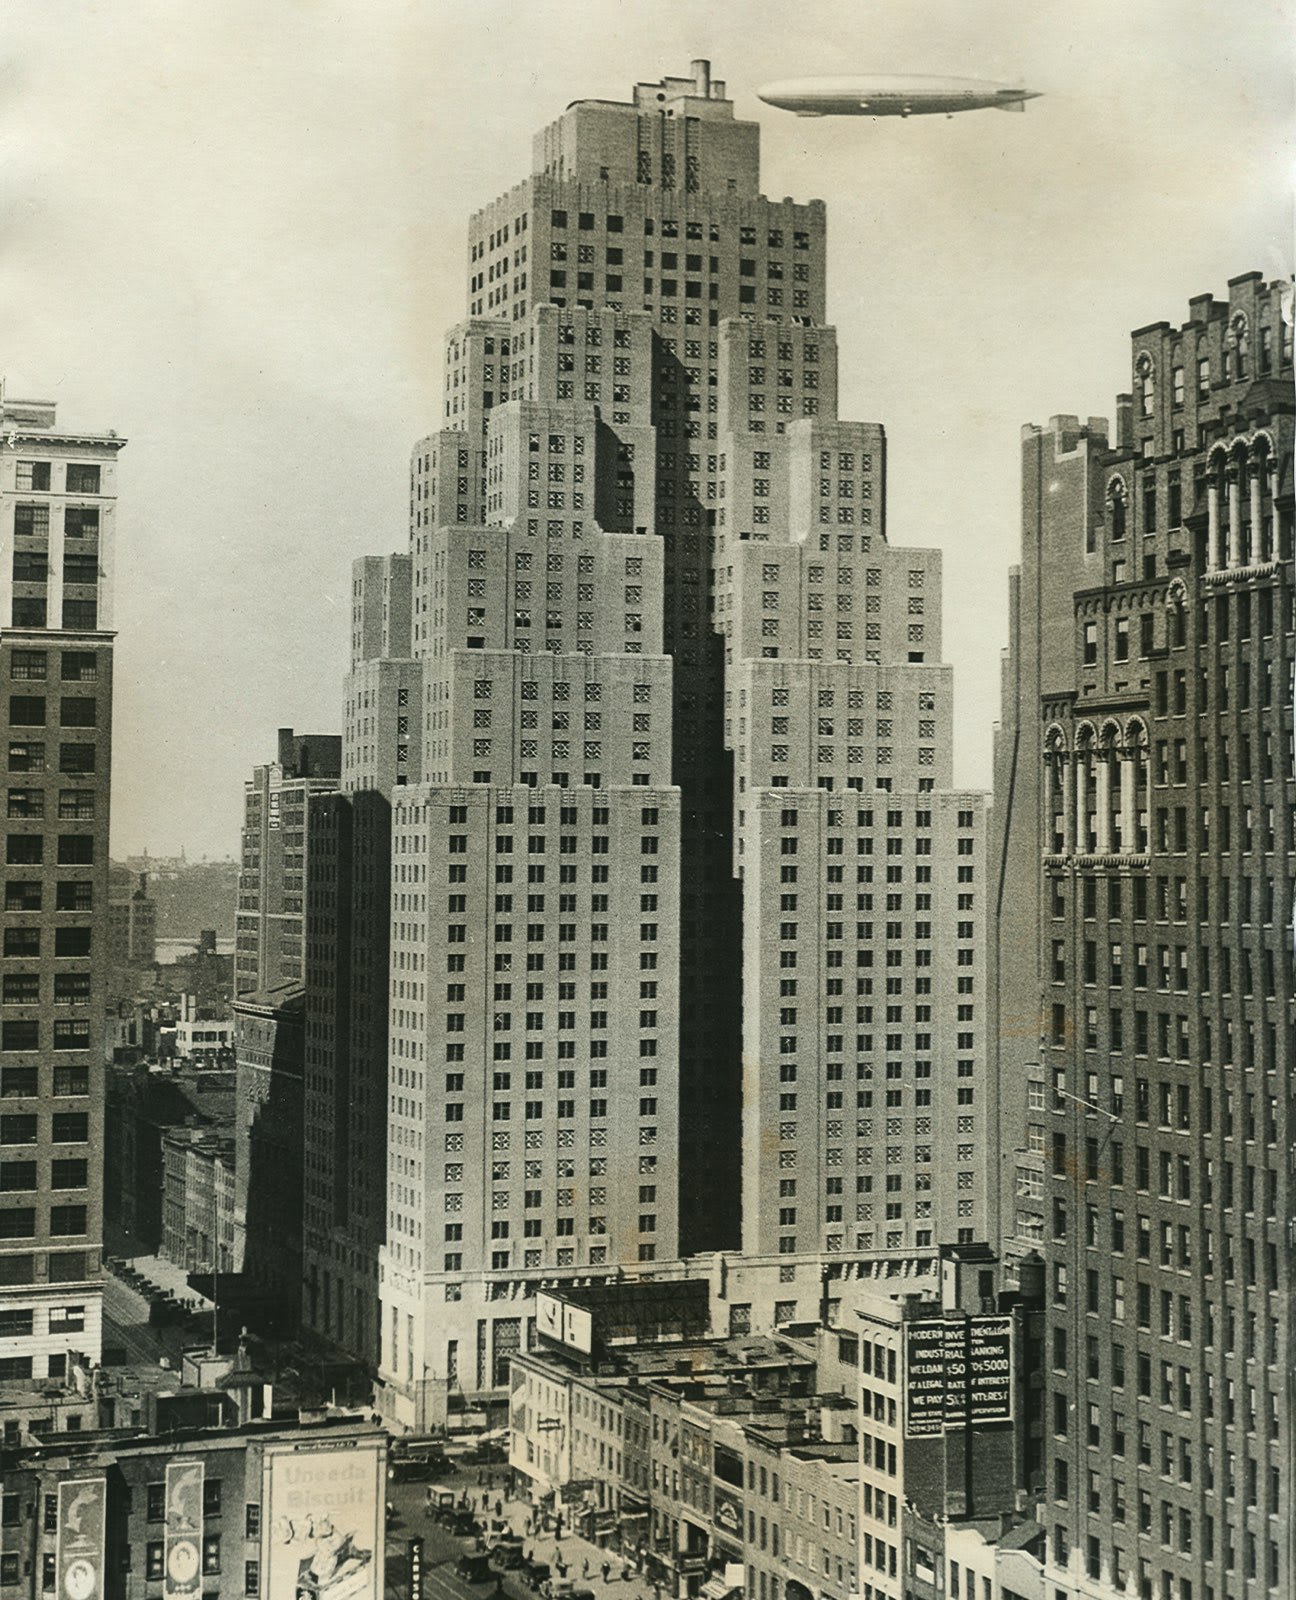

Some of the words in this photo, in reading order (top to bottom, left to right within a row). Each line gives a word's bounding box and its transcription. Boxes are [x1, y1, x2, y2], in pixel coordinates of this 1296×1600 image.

[908, 1330, 943, 1340] MODERN
[922, 1364, 943, 1374] LOAN
[946, 1363, 966, 1375] $50
[977, 1359, 1009, 1373] $5000
[922, 1380, 944, 1389] LEGAL
[947, 1380, 966, 1389] RATE
[977, 1376, 1010, 1386] INTEREST
[912, 1395, 926, 1405] WE
[926, 1395, 944, 1404] PAY
[971, 1391, 1008, 1401] NTEREST
[286, 1463, 367, 1485] Uneeda
[287, 1487, 367, 1508] Biscuit
